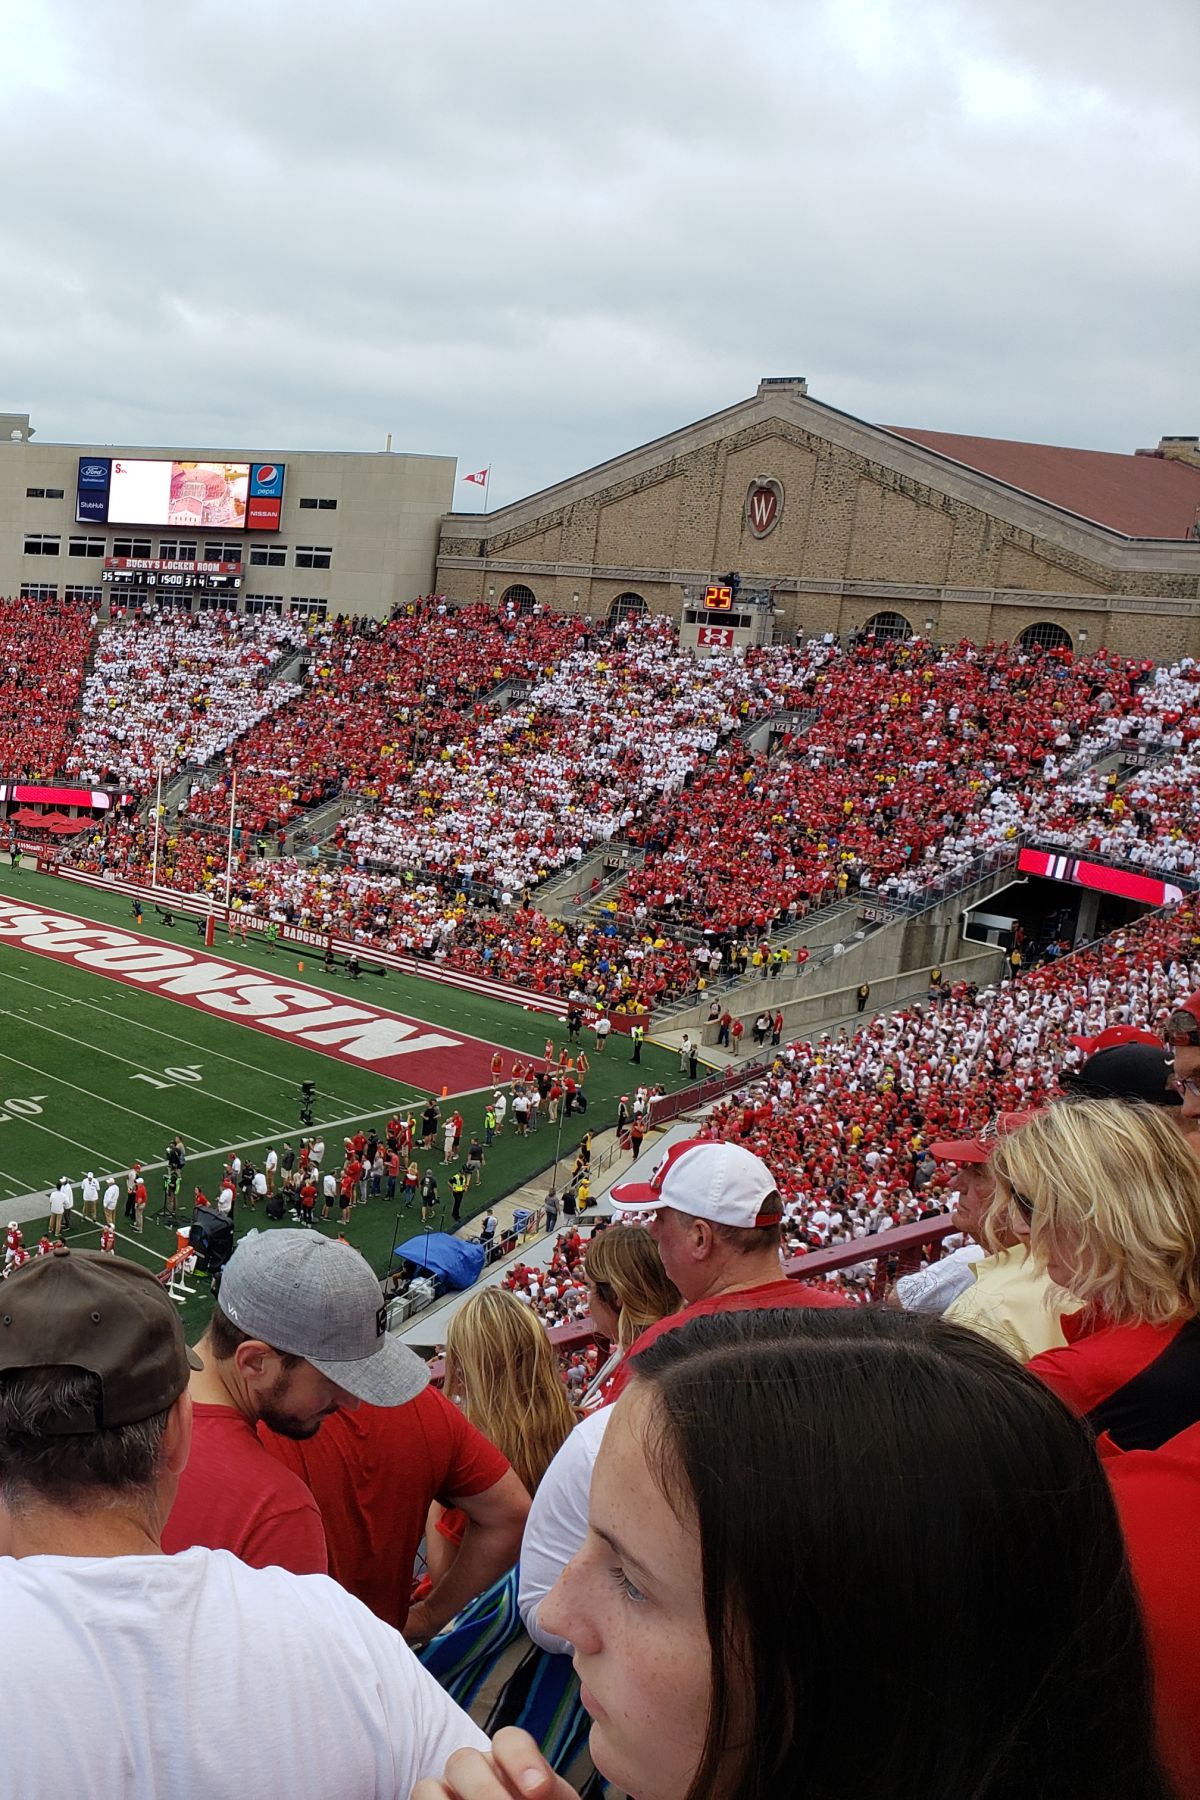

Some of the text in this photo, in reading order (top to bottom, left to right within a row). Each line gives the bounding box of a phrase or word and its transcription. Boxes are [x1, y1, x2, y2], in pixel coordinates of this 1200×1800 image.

[80, 501, 104, 509] StubHub
[753, 493, 775, 526] W
[250, 510, 278, 518] NISSAN
[126, 559, 220, 573] BUCKY'S LOCKER ROOM
[161, 574, 182, 585] 15:00
[706, 587, 731, 608] 25
[228, 910, 329, 948] WISCONS BADGERS
[128, 1065, 205, 1091] 10
